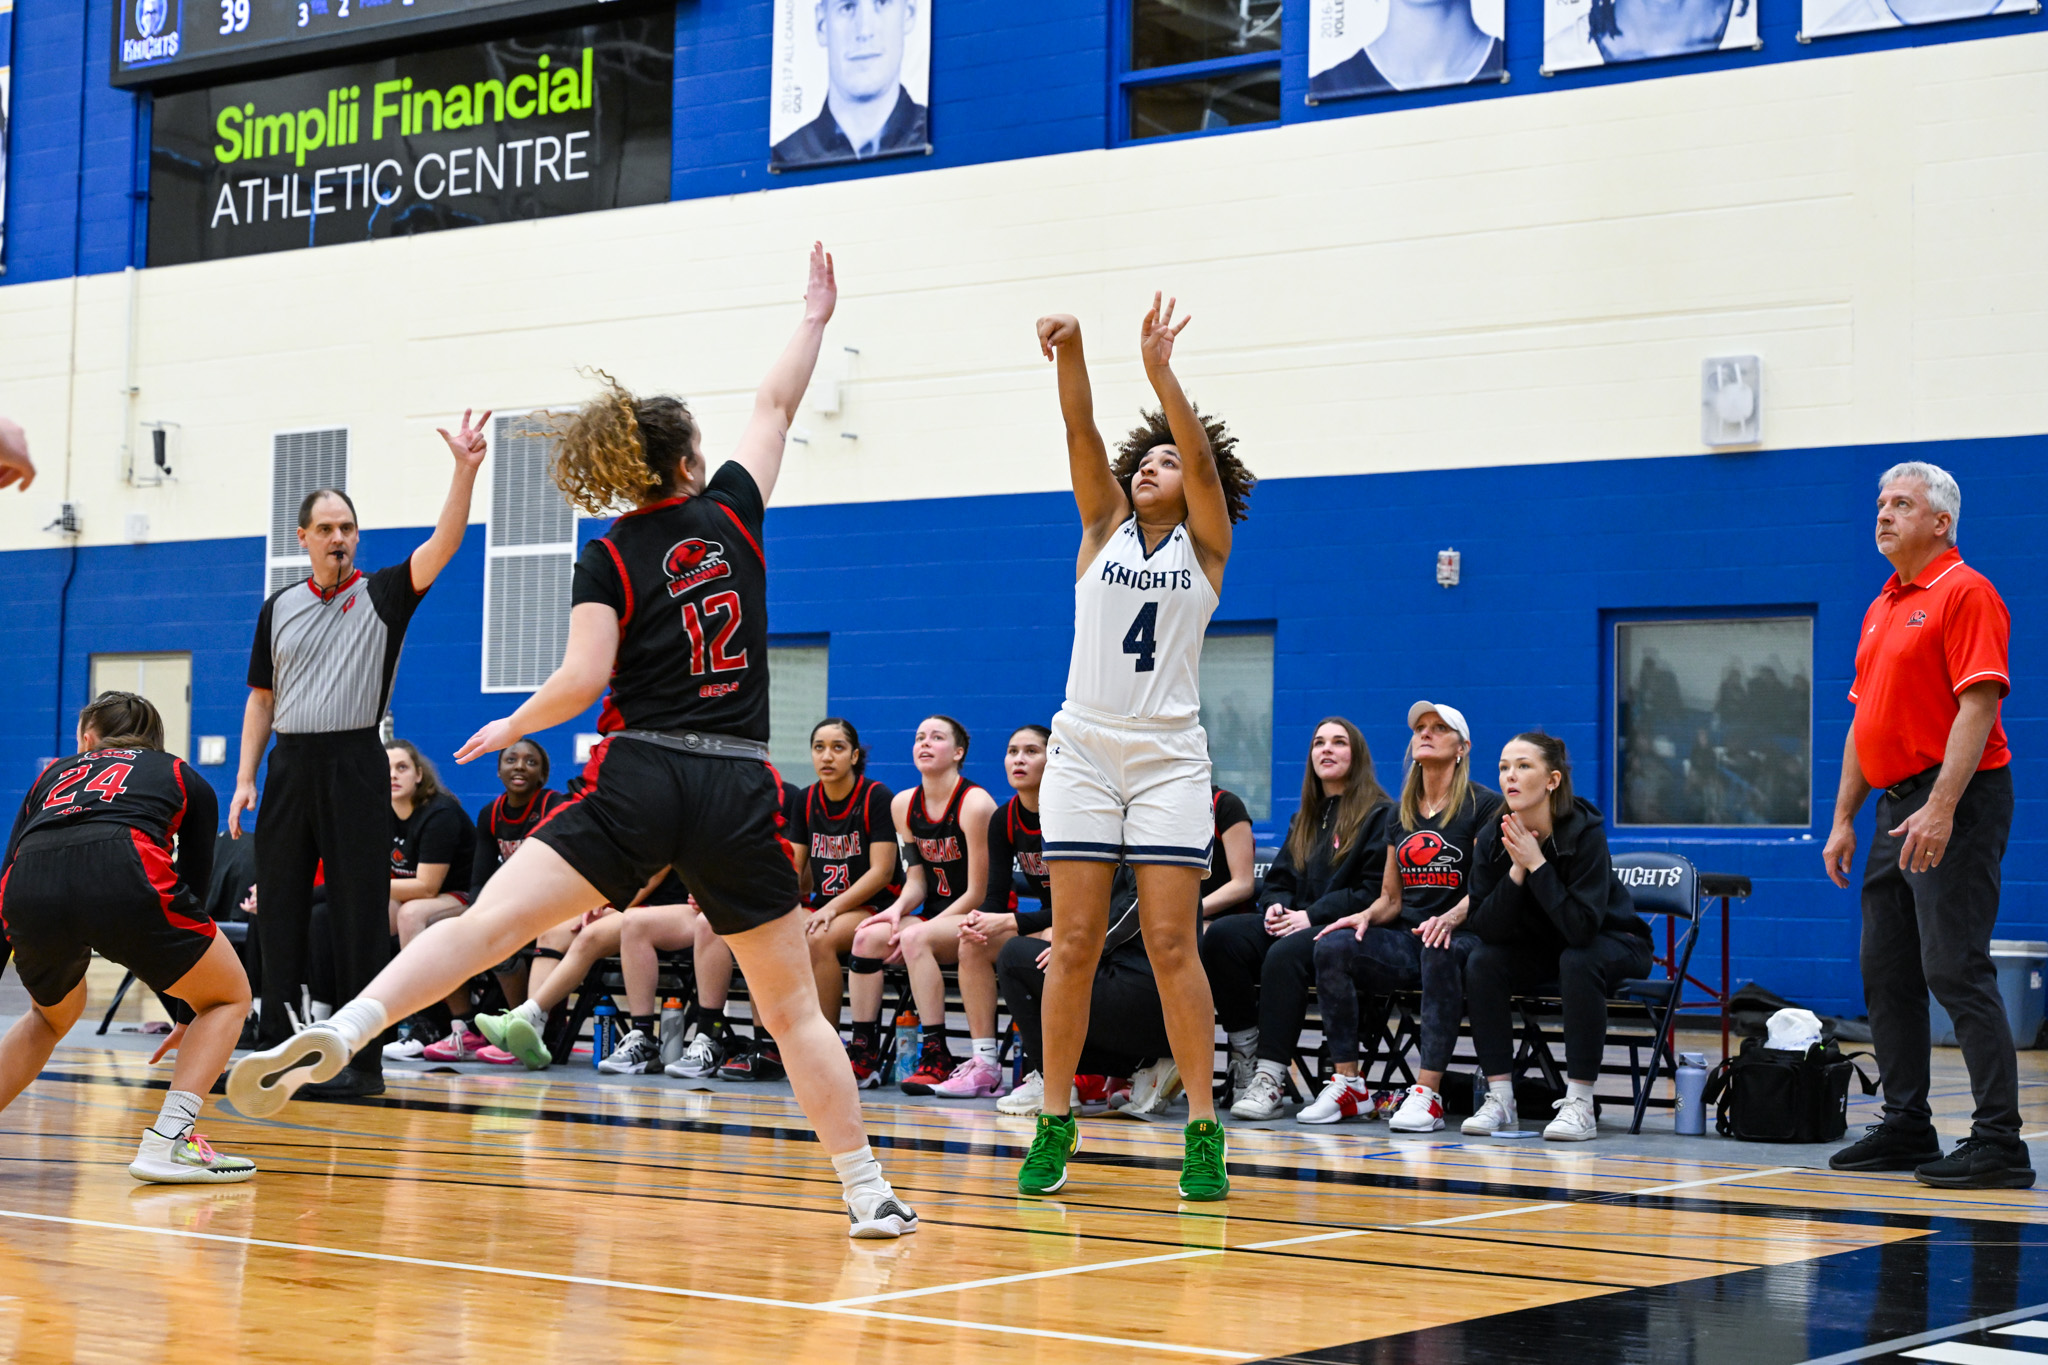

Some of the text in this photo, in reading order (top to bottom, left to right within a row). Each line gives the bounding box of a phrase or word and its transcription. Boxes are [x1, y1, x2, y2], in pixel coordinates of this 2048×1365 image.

[219, 0, 250, 35] 39
[297, 2, 310, 28] 3
[123, 31, 179, 63] KNIGHTS
[214, 47, 594, 167] Simplii Financial
[793, 86, 803, 114] GOLF
[211, 130, 591, 229] ATHLETIC CENTRE
[1100, 560, 1192, 592] KNIGHTS
[681, 590, 748, 676] 12
[1122, 602, 1158, 673] 4
[42, 762, 134, 811] 24
[821, 863, 851, 896] 23
